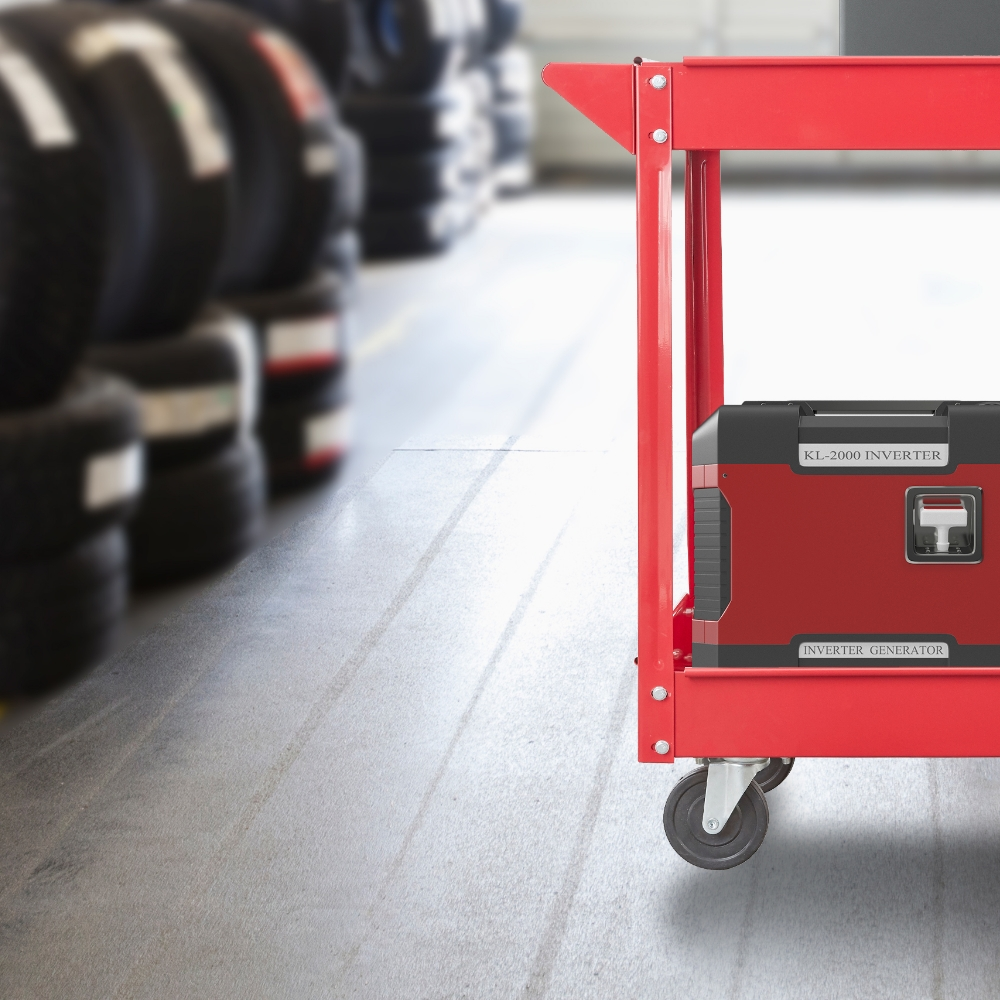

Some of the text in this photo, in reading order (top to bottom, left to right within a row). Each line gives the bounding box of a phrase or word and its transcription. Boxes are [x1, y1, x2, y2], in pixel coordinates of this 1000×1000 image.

[803, 450, 942, 461] KL-2000 INVERTER
[803, 645, 944, 656] INVERTER GENERATOR
